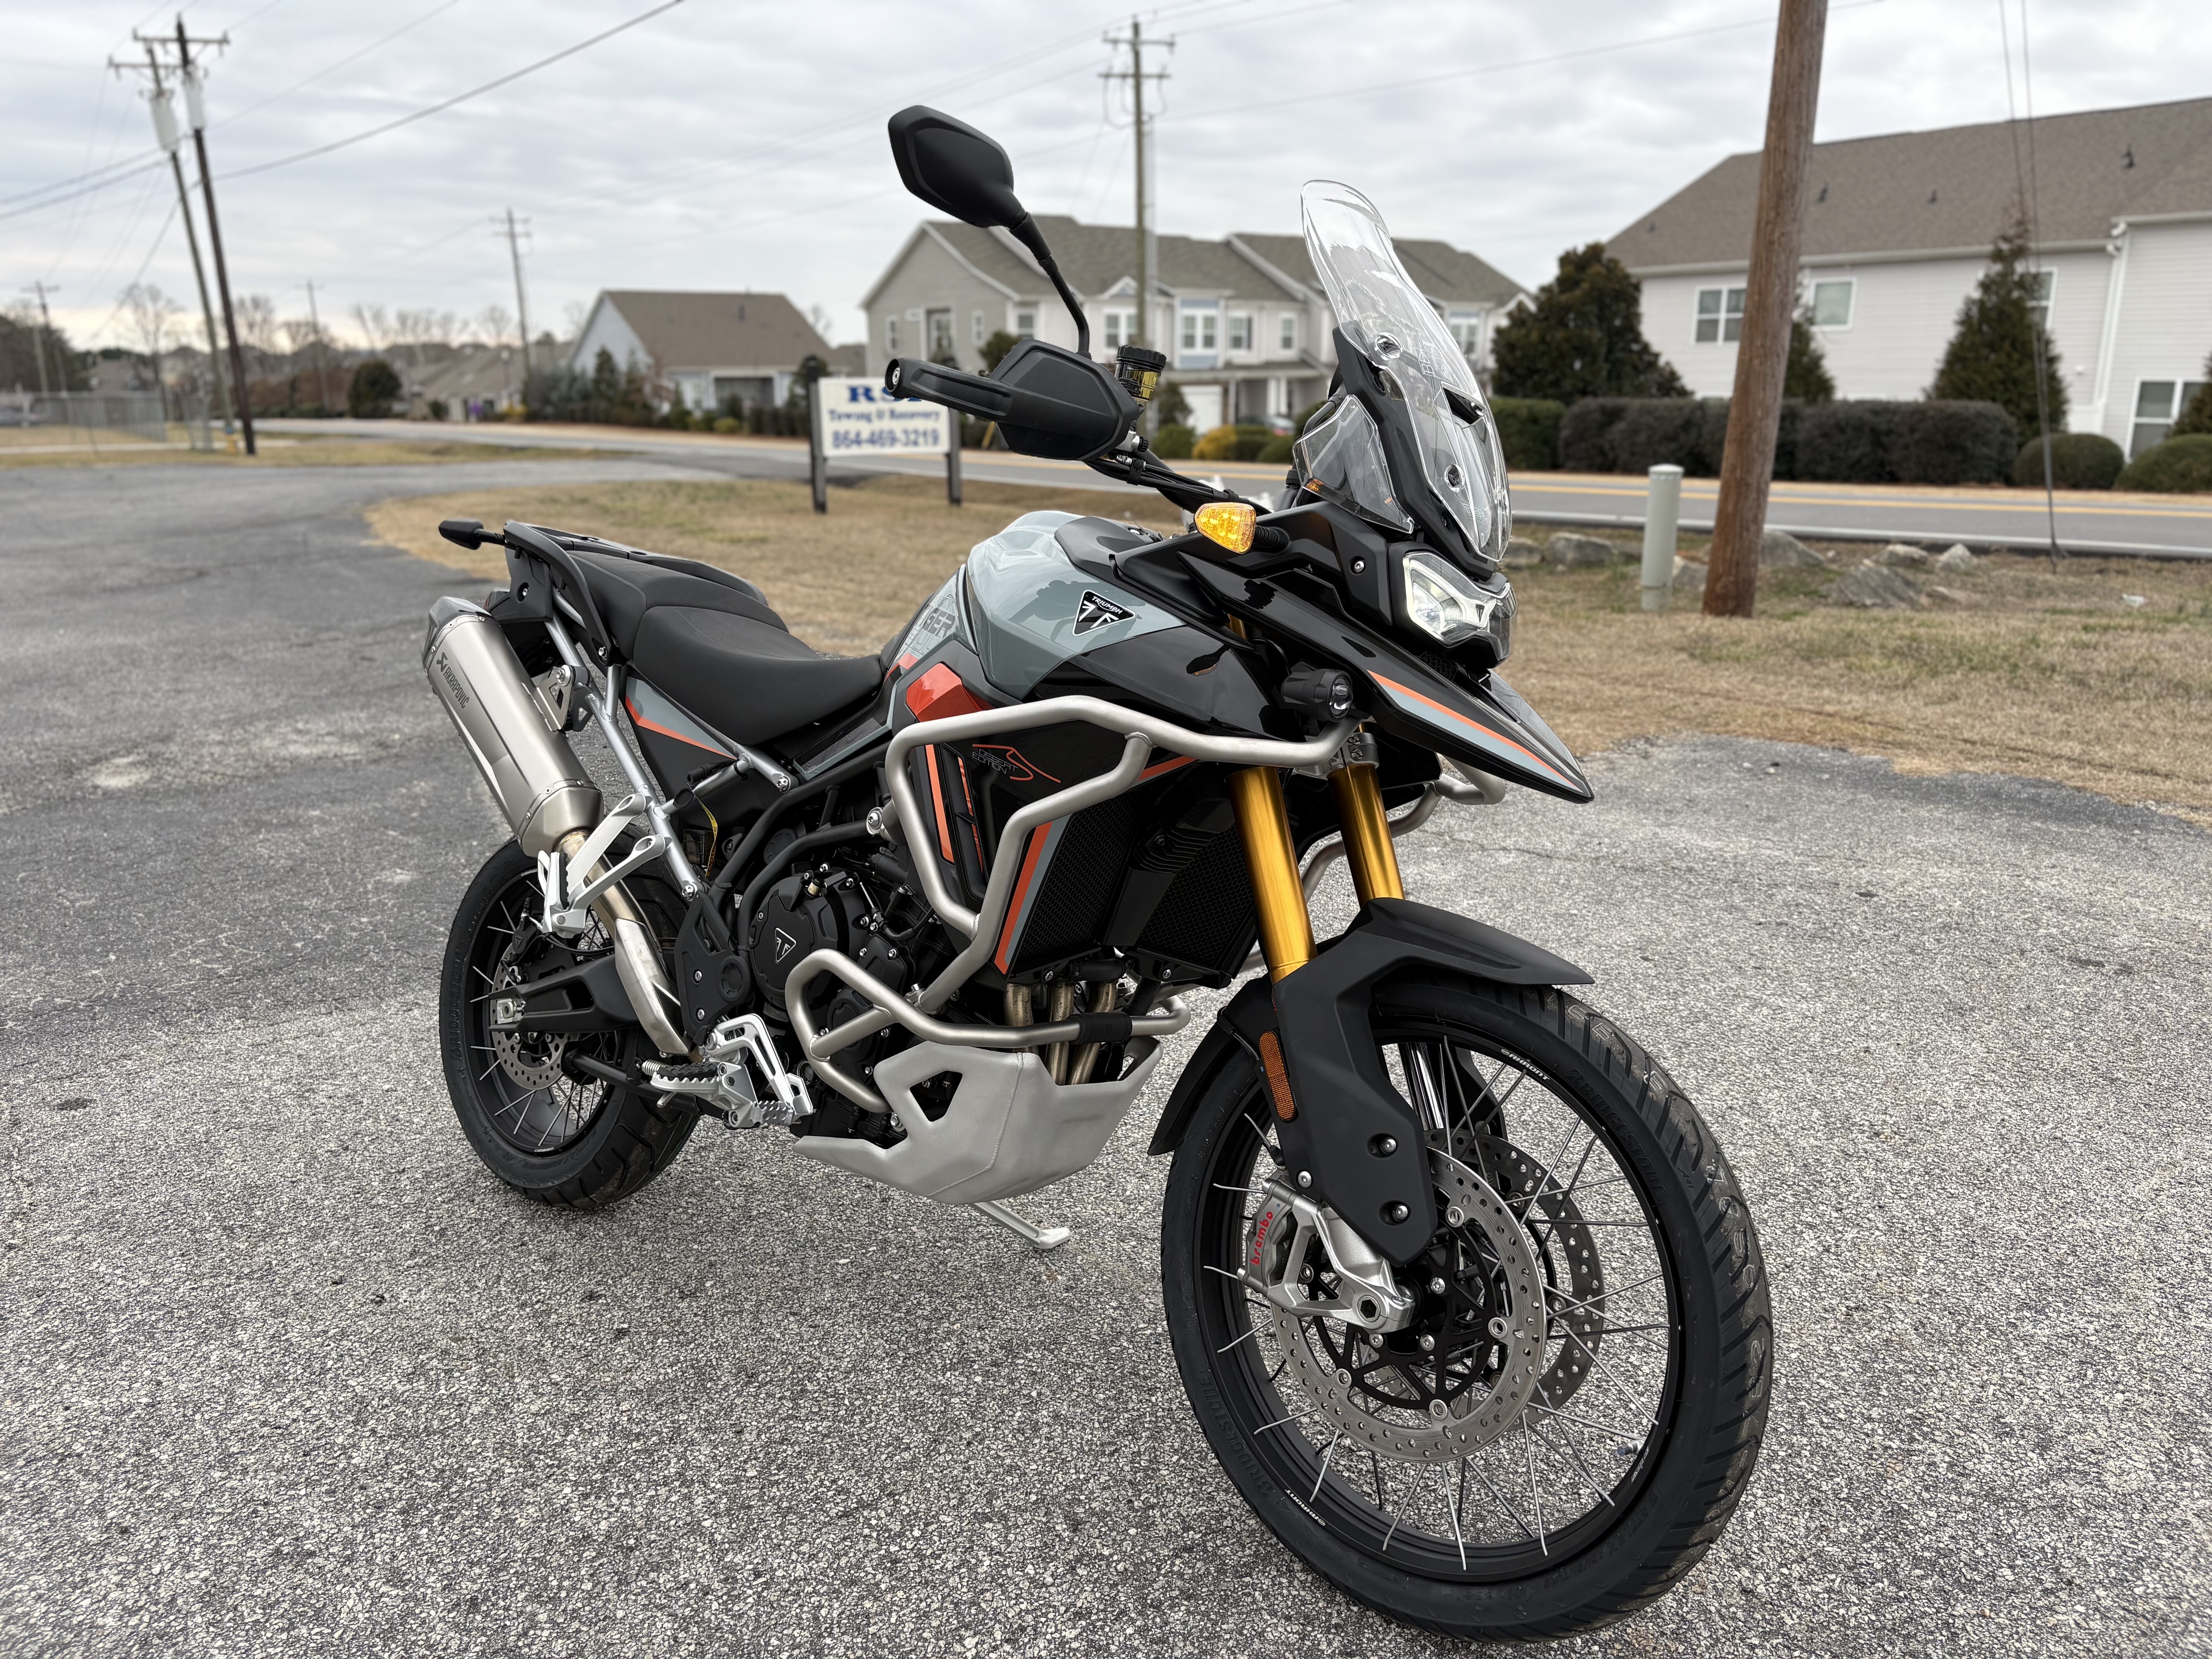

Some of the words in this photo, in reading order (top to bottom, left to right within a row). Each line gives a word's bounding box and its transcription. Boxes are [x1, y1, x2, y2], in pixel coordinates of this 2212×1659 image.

[828, 409, 872, 422] Towing
[876, 409, 886, 419] &
[889, 408, 940, 422] Recovery
[832, 429, 939, 448] 864-469-3219
[1092, 596, 1123, 615] TRIUMPH
[972, 752, 1007, 774] EDITION
[979, 749, 1018, 772] DESERT
[1565, 1068, 1667, 1197] BRIDGESTONE
[1250, 1211, 1273, 1266] brembo
[1199, 1377, 1277, 1497] BRIDGESTONE
